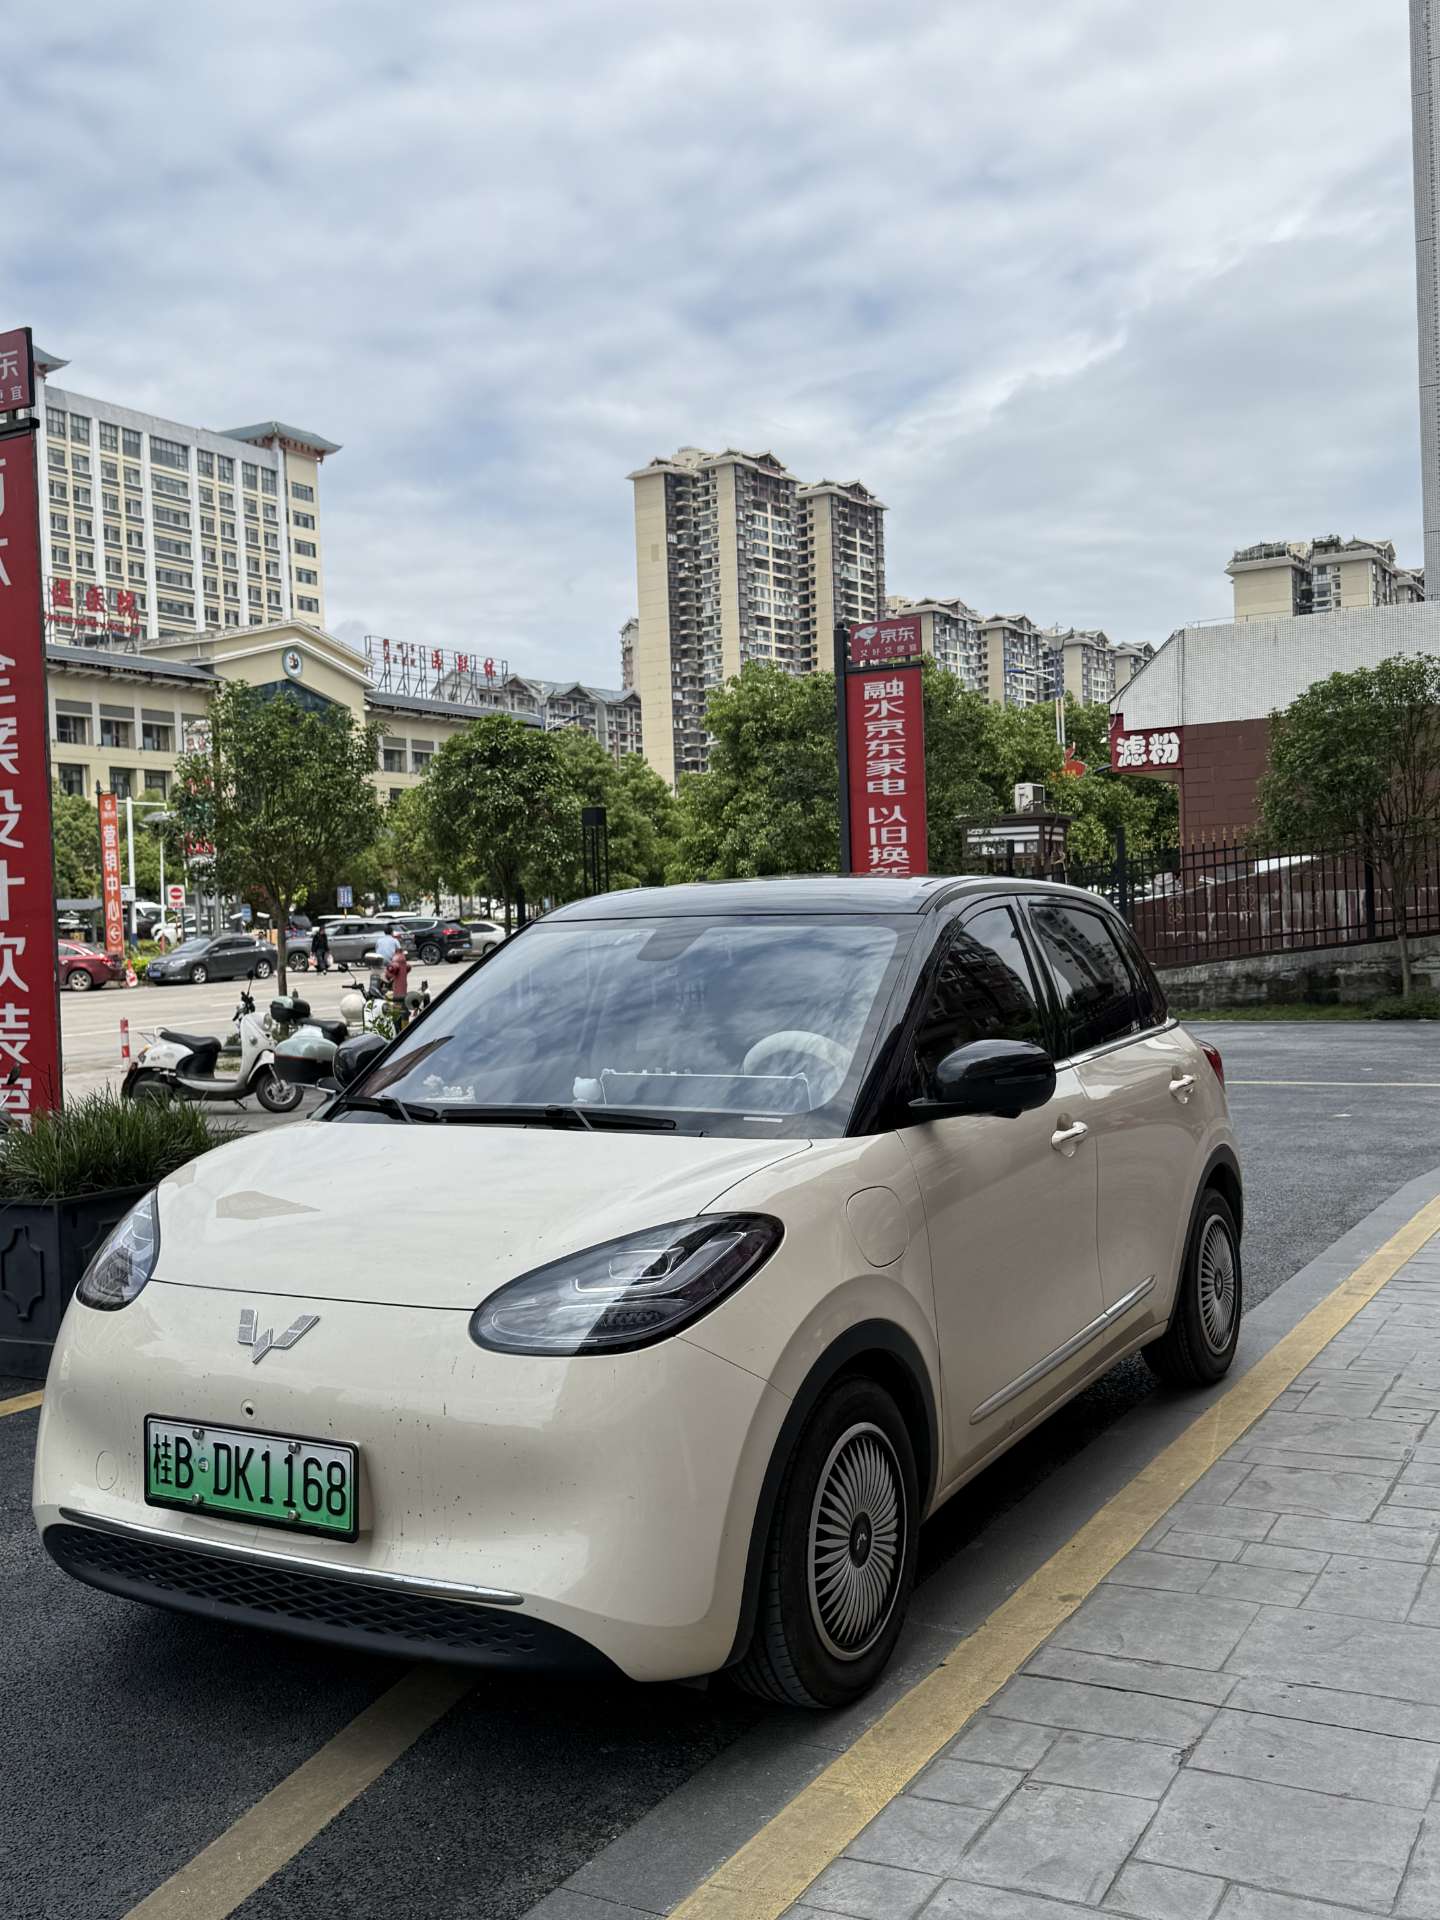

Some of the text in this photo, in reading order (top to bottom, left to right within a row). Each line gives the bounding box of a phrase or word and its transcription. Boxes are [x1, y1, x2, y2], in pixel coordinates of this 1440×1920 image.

[880, 626, 915, 644] 京东
[863, 676, 907, 796] 融水京东家电
[1116, 732, 1180, 768] 滤粉
